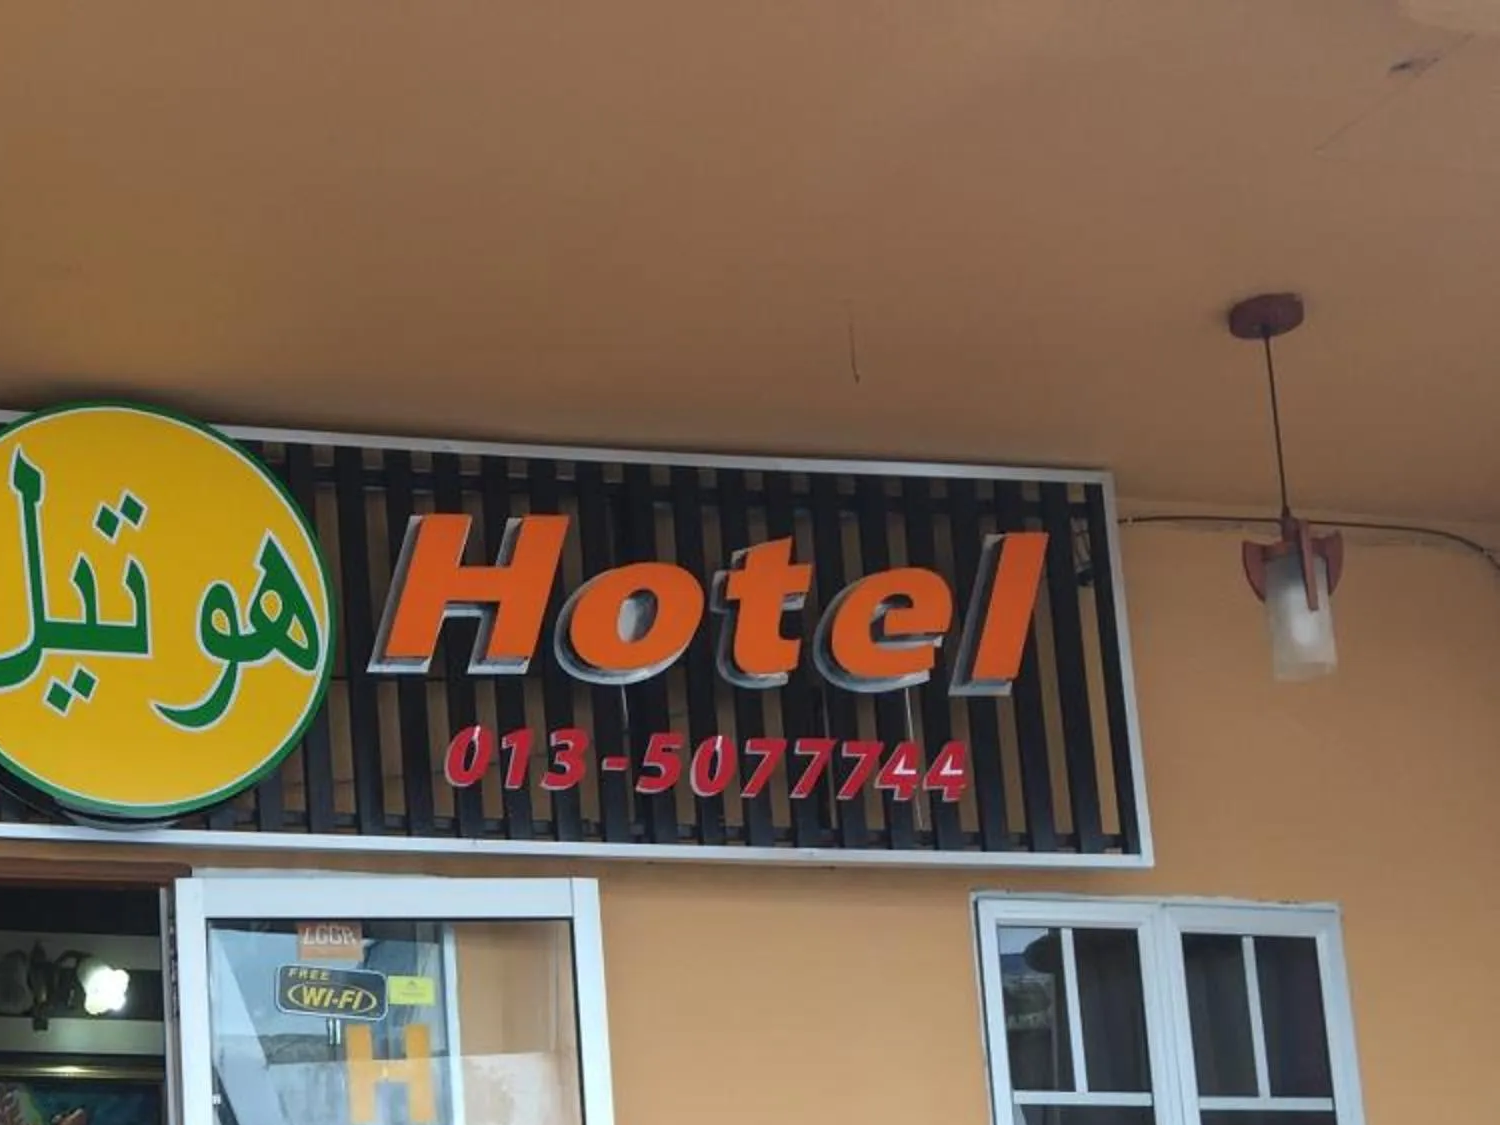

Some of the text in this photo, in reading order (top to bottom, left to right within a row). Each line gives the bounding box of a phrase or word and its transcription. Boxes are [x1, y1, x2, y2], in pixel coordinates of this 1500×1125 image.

[367, 513, 1049, 696] Hotel
[444, 725, 968, 802] 013-5077744
[287, 967, 329, 981] FREE
[302, 986, 363, 1010] WI-FI
